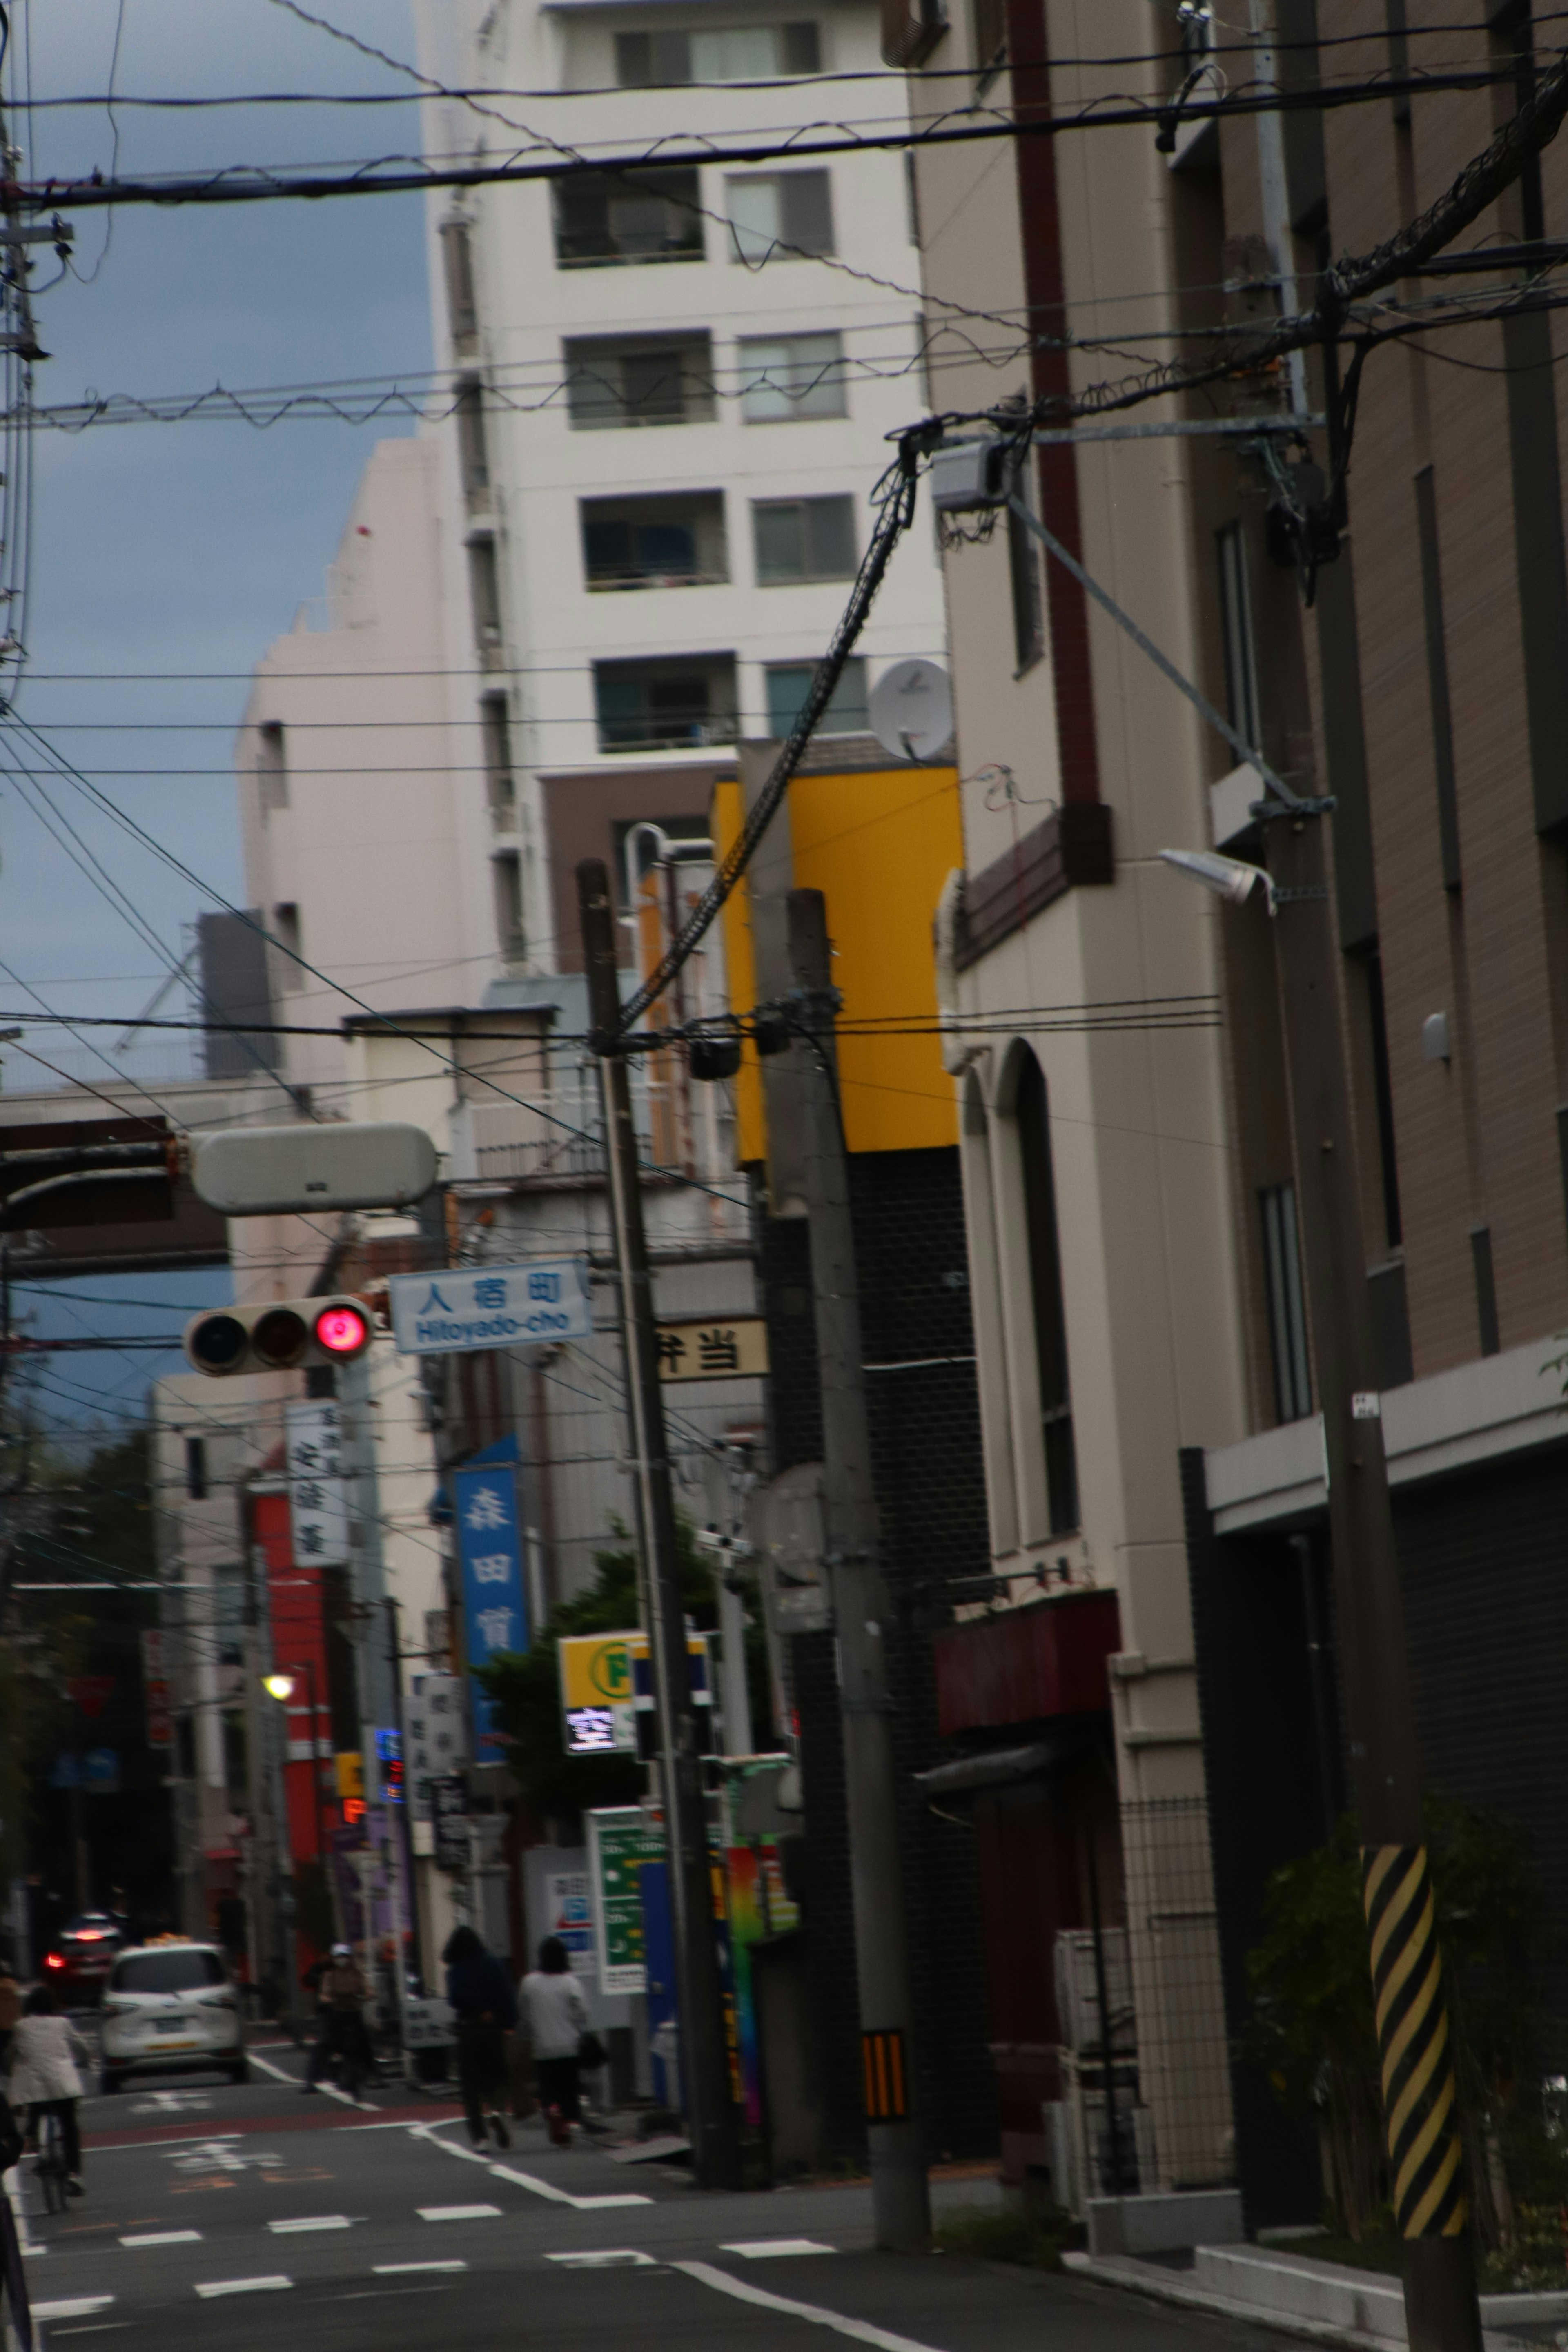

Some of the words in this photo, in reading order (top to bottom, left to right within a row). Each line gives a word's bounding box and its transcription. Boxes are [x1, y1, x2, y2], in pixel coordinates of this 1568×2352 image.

[418, 1272, 560, 1314] 人宿町
[416, 1310, 569, 1343] Hitoyado-cho
[464, 1486, 517, 1704] 森田質
[566, 1707, 617, 1751] 空
